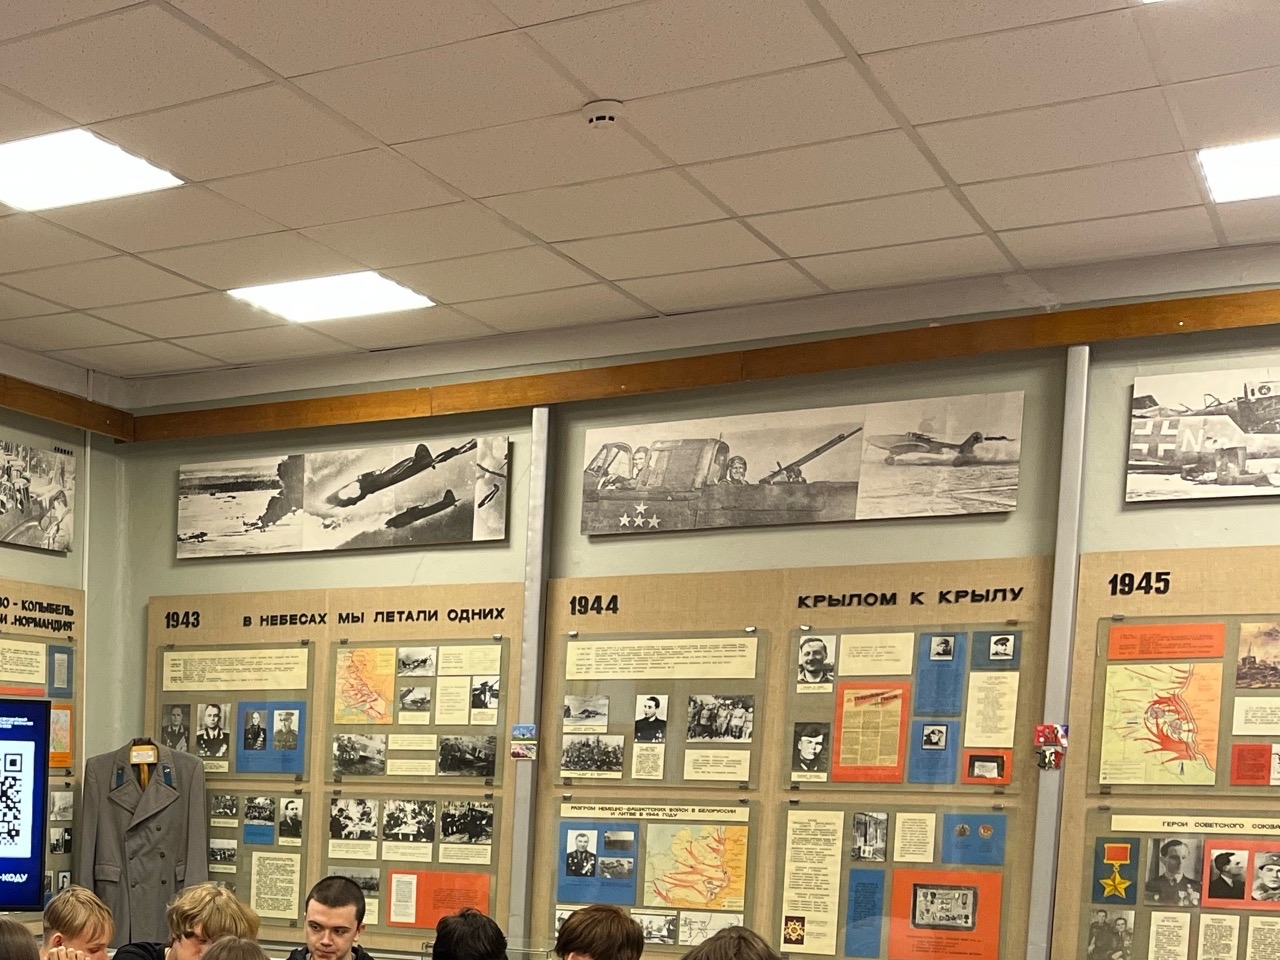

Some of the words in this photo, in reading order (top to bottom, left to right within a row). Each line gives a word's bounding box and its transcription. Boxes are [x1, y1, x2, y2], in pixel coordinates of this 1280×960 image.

[1108, 571, 1171, 596] 1945
[21, 599, 75, 617] КОЛЫБЕЛЬ
[569, 594, 619, 616] 1944
[797, 591, 897, 609] КРЫЛОМ
[910, 590, 925, 606] К
[938, 586, 1024, 604] КРЫЛУ
[165, 611, 201, 629] 1943
[243, 616, 252, 627] В
[260, 612, 327, 627] НЕБЕСАХ
[338, 611, 365, 625] МЫ
[373, 609, 439, 623] ЛЕТАЛИ
[447, 607, 505, 623] ОДНИХ
